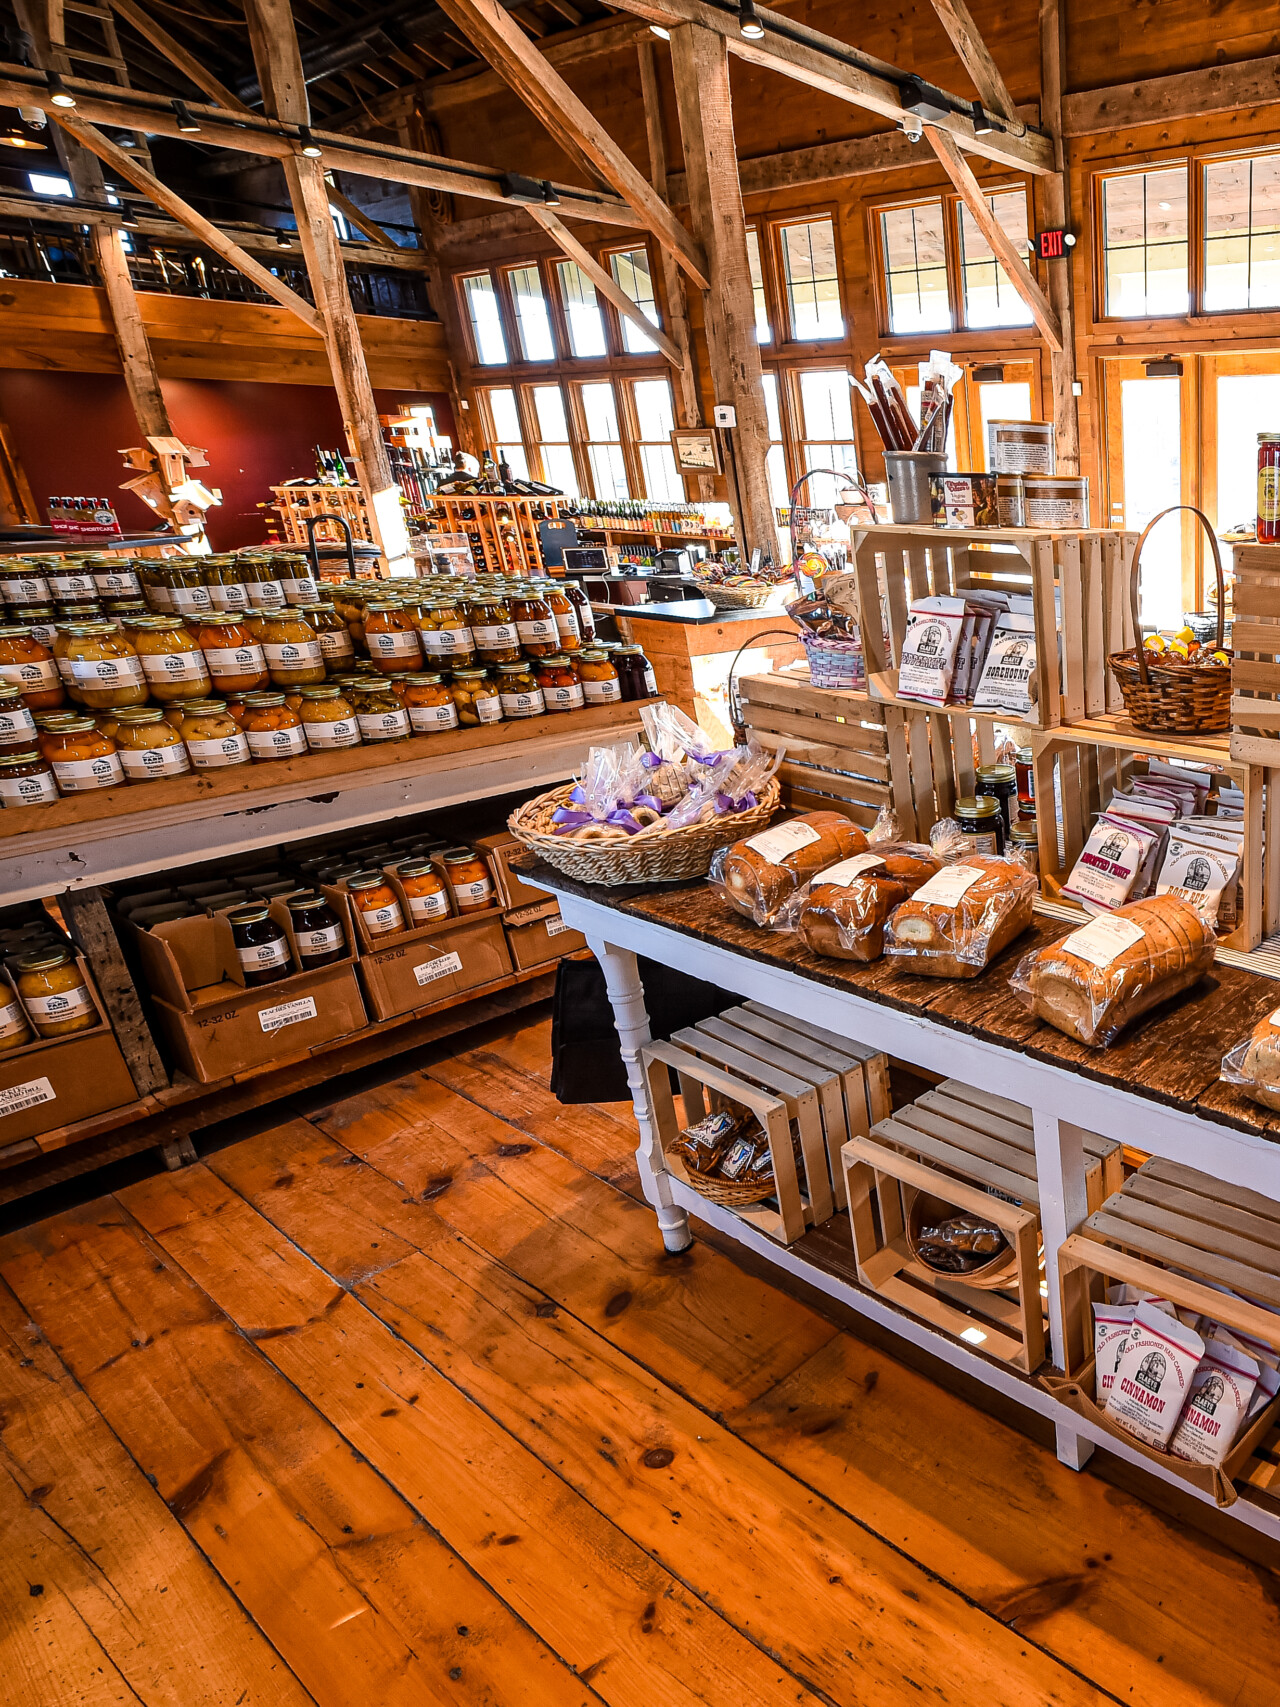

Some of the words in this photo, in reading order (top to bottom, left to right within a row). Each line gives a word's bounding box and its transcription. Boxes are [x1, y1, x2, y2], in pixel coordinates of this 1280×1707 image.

[1041, 231, 1063, 258] EXIT
[985, 666, 1029, 680] HOREHOUND
[504, 848, 521, 857] 12-32
[1180, 850, 1205, 858] FASHIONED
[1110, 863, 1131, 880] FRUIT
[1186, 878, 1206, 888] CLAEYS
[1167, 885, 1189, 898] ROOT
[515, 909, 533, 919] 12-32
[374, 953, 395, 964] 12-32
[197, 1014, 224, 1029] 12-32
[1096, 1342, 1105, 1353] OLD
[1124, 1344, 1134, 1354] OLD
[1135, 1340, 1164, 1350] FASHIONED
[1164, 1347, 1175, 1361] HARD
[1137, 1373, 1158, 1387] CLAEYS
[1222, 1371, 1232, 1384] HARD
[1120, 1378, 1166, 1413] CINNAMON
[1194, 1396, 1213, 1409] CLAEYS
[1181, 1405, 1221, 1437] NNAMON
